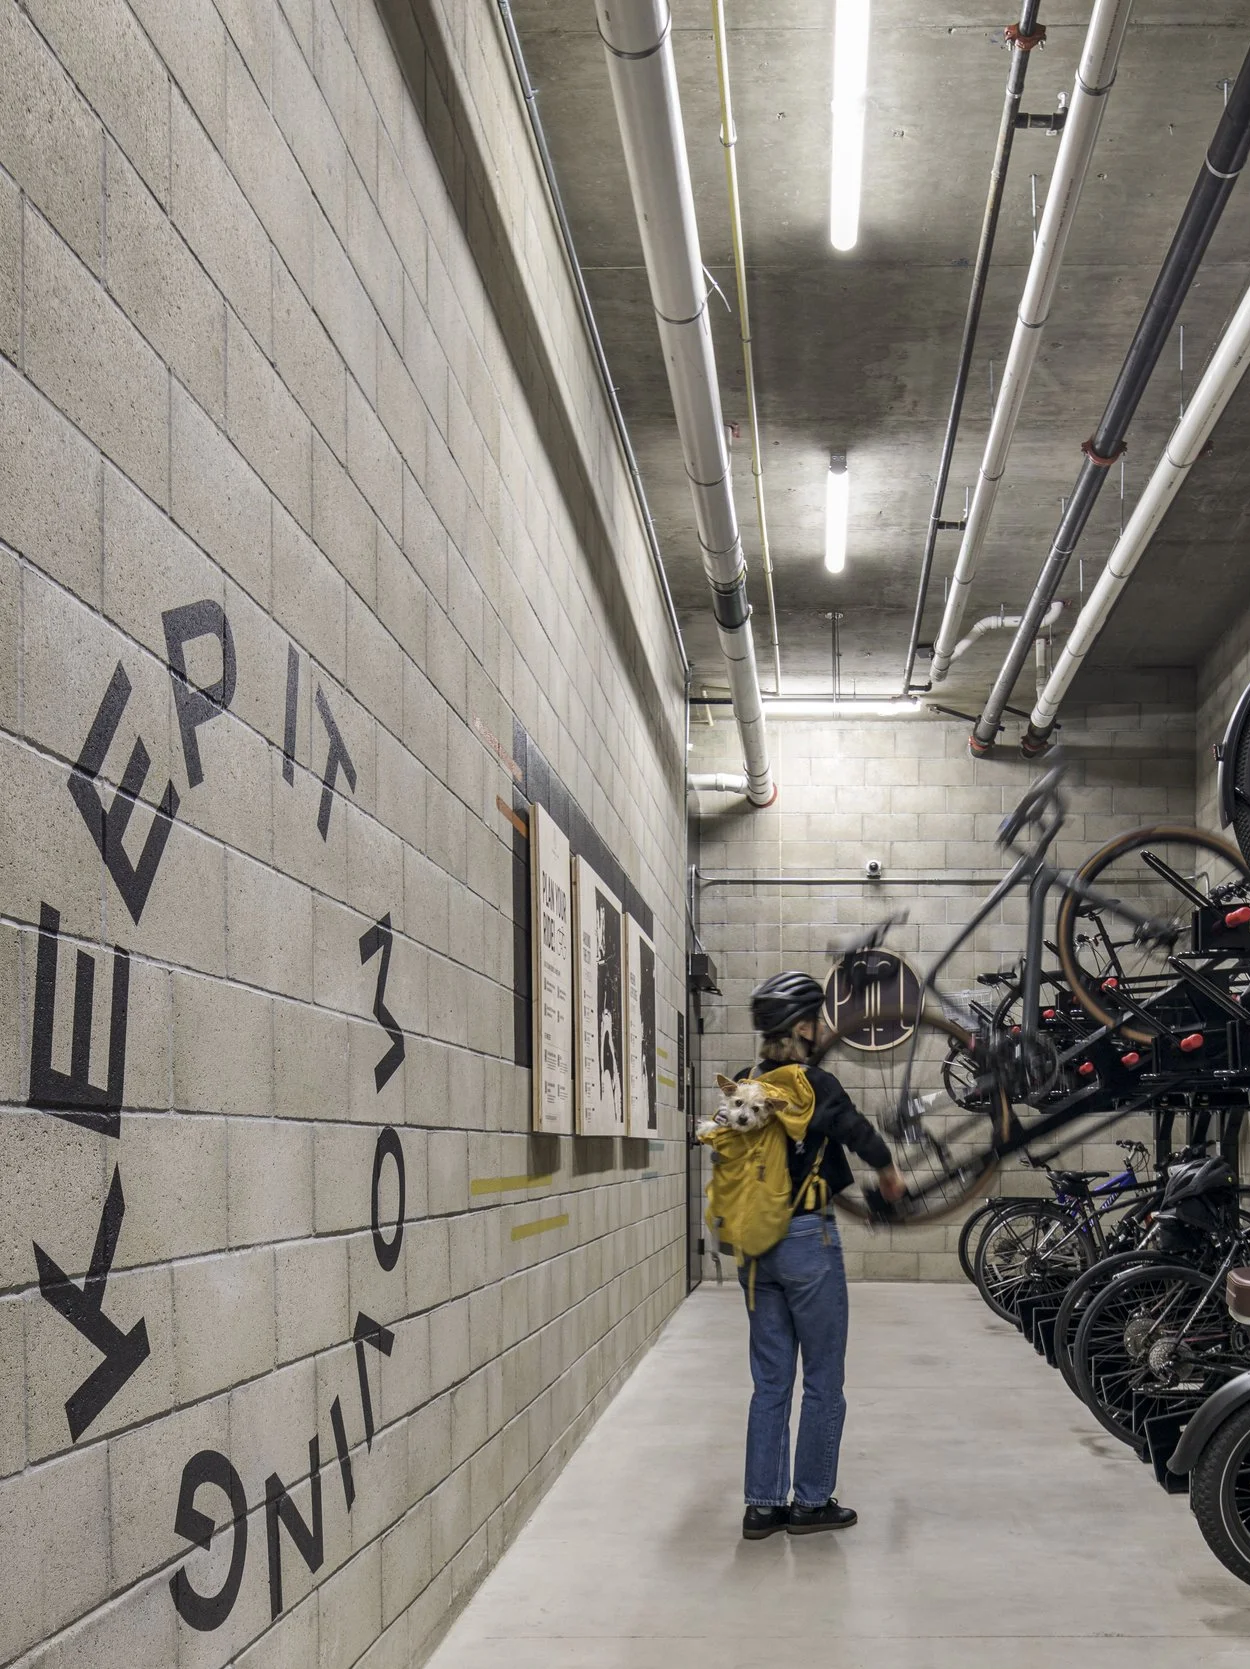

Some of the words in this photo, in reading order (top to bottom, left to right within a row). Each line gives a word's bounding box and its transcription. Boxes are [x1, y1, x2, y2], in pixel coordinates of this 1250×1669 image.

[281, 641, 357, 843] IT
[542, 870, 555, 912] PLAN
[555, 883, 567, 924] YOUR
[543, 911, 556, 952] RIDE!
[28, 599, 237, 1444] KEEP
[171, 911, 406, 1633] MOVING
